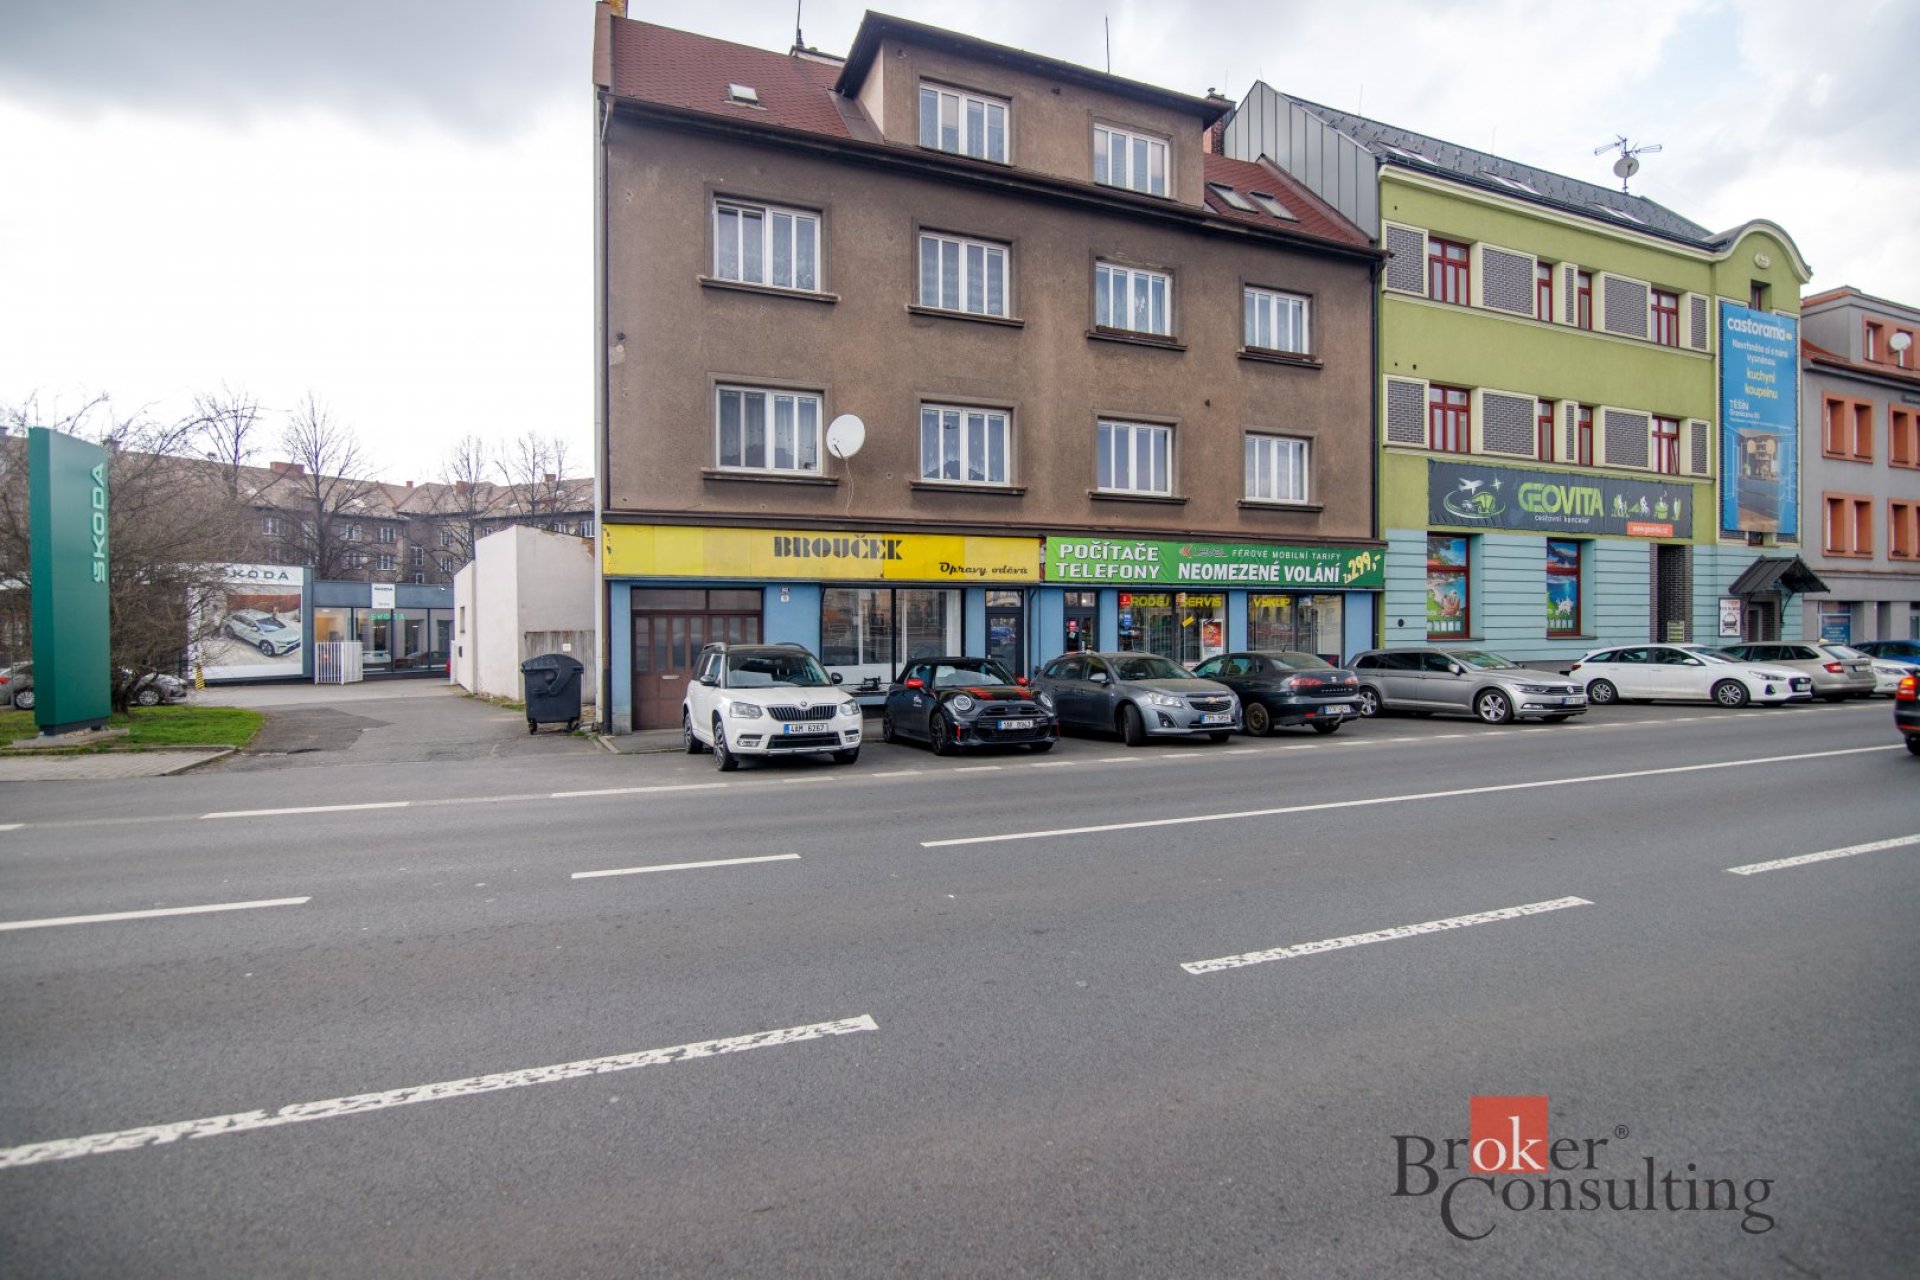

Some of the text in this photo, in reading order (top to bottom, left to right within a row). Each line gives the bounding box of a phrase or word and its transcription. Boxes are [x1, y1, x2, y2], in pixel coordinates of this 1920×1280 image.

[1727, 318, 1786, 341] castorama
[1518, 481, 1605, 517] GEOVITA
[773, 534, 904, 560] BROUČEK
[1059, 540, 1160, 562] POČÍTAČE
[1272, 548, 1309, 560] MOBILNÍ
[1312, 551, 1341, 561] TARIFY
[939, 561, 987, 577] Opravy
[1055, 562, 1161, 580] TELEFONY
[1178, 560, 1341, 583] NEOMEZENÉ VOLÁNÍ
